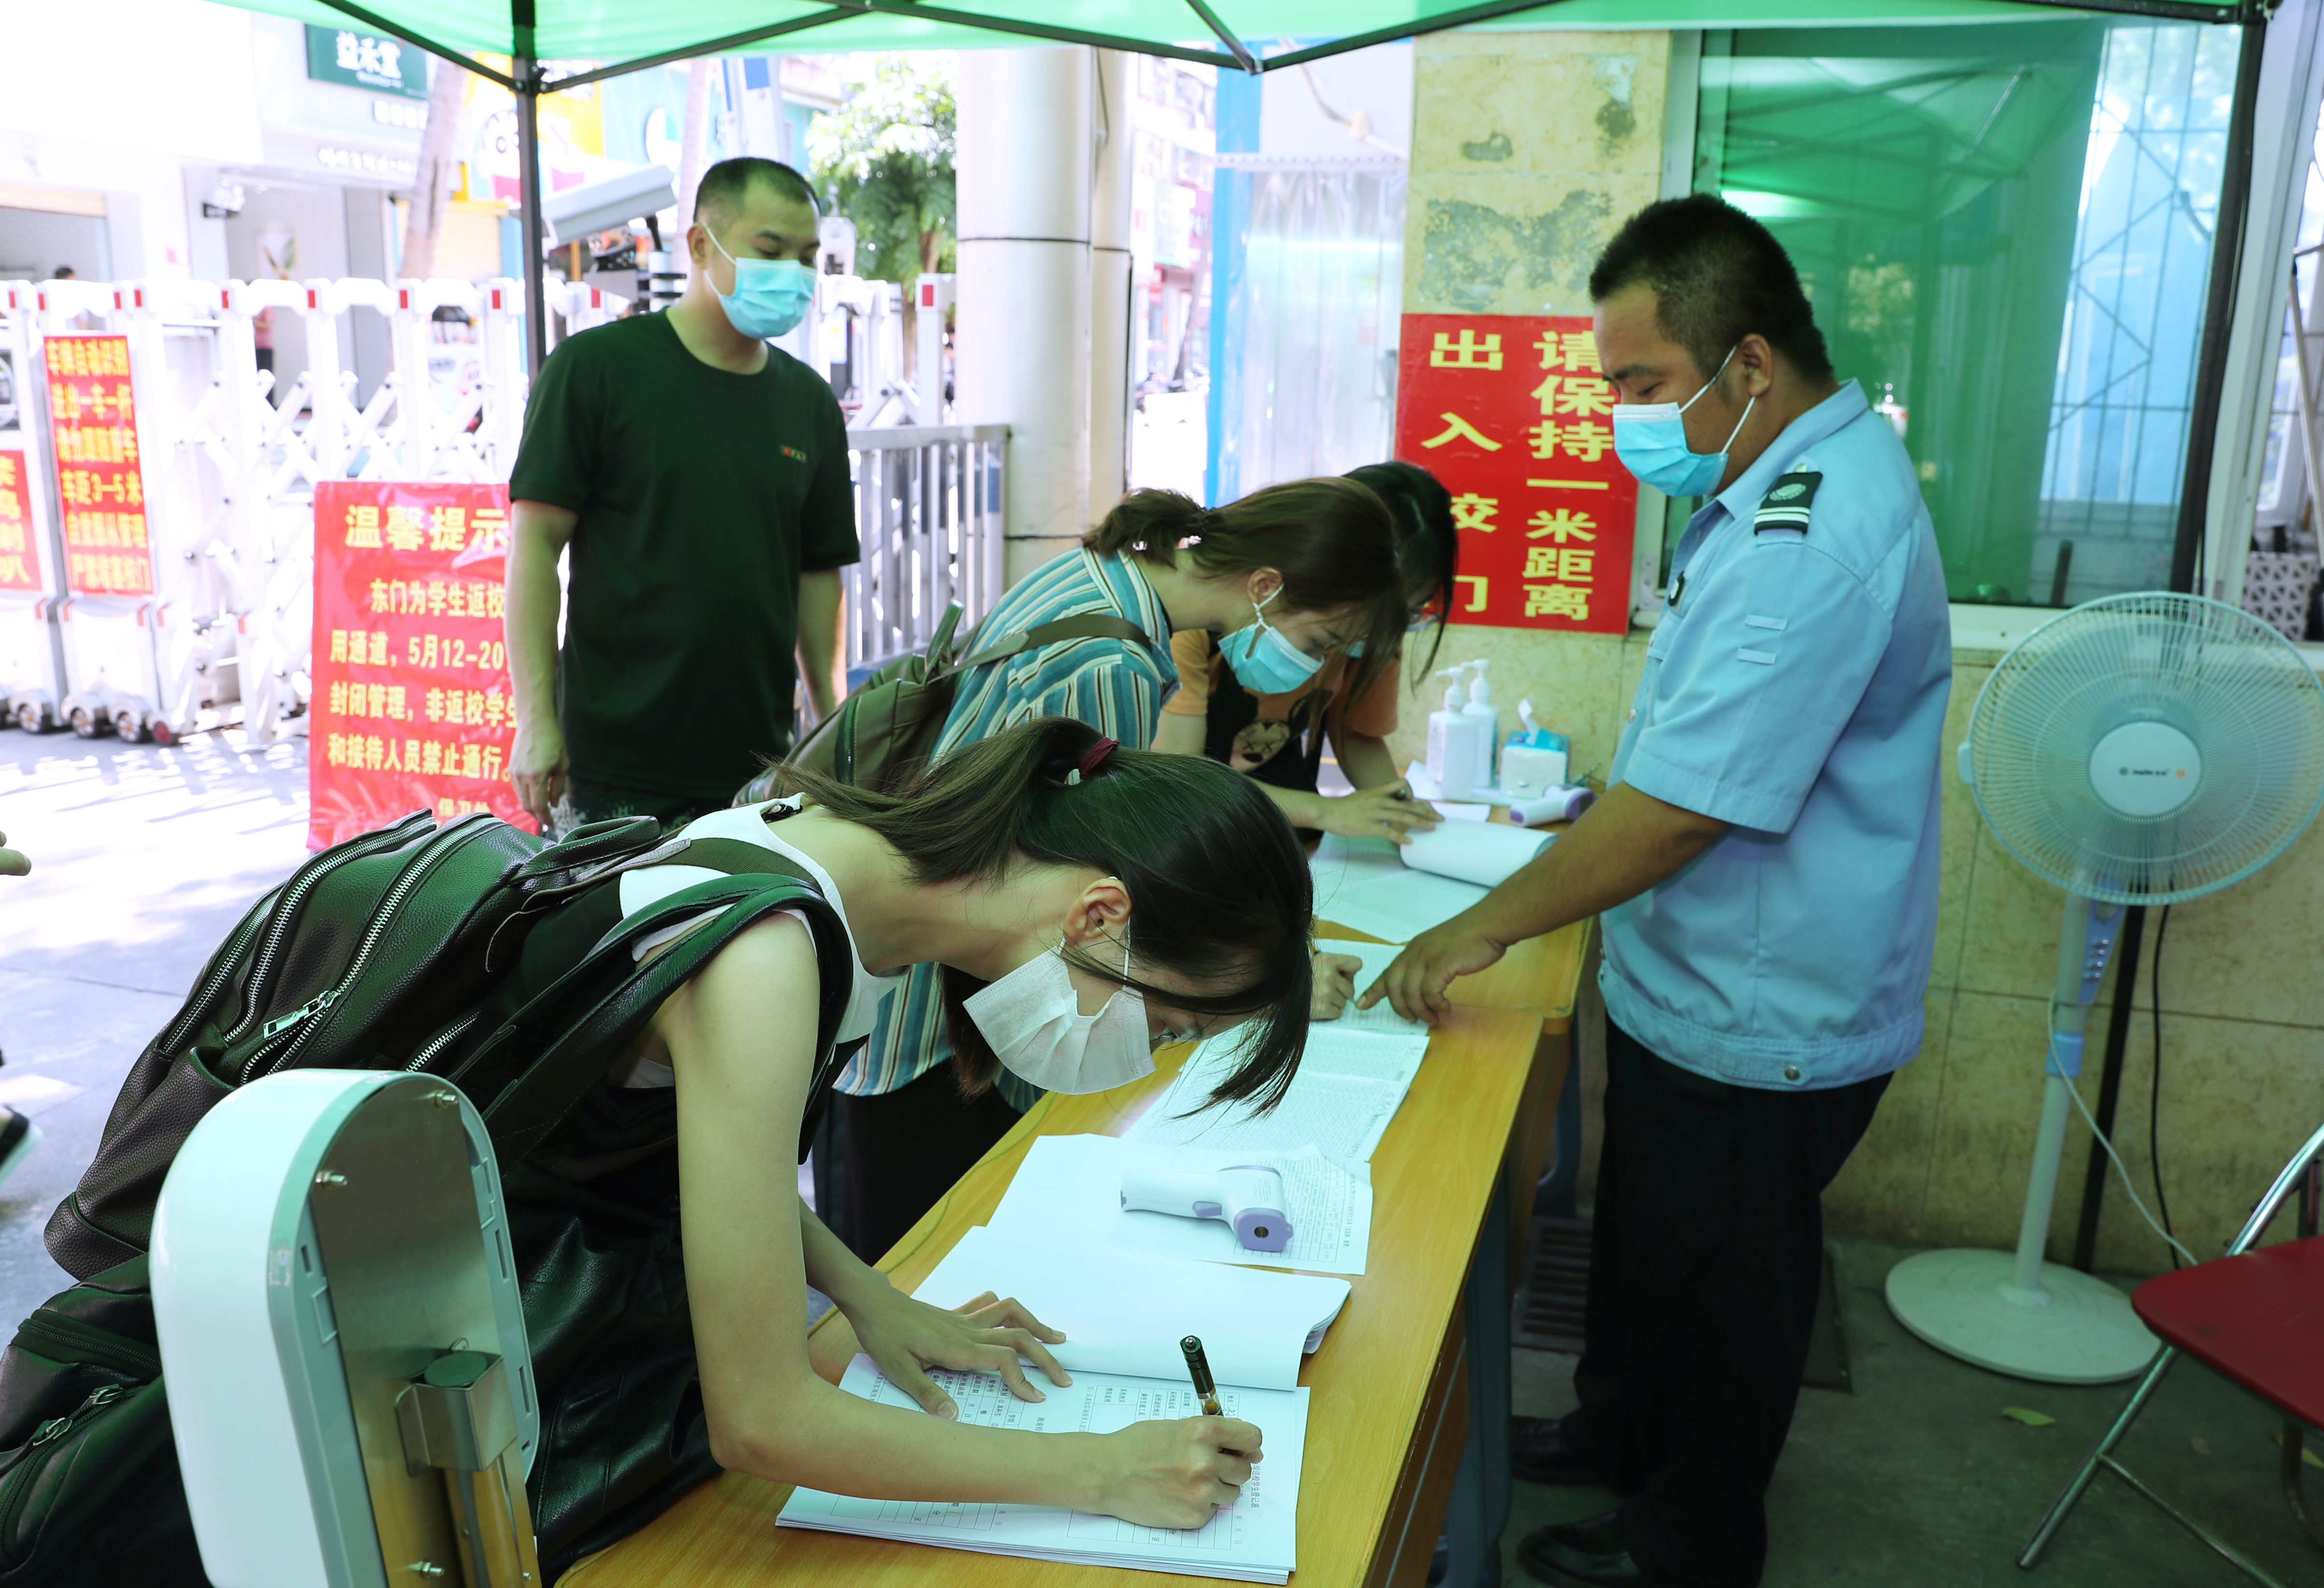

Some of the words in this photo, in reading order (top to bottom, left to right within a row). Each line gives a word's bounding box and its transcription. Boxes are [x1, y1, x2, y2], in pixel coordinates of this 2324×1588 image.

[1522, 330, 1615, 620] 请保持一米距离
[345, 505, 510, 551] 温馨提示
[370, 577, 505, 619] 东门为学生返校
[329, 629, 511, 674] 用通道，5月12-20
